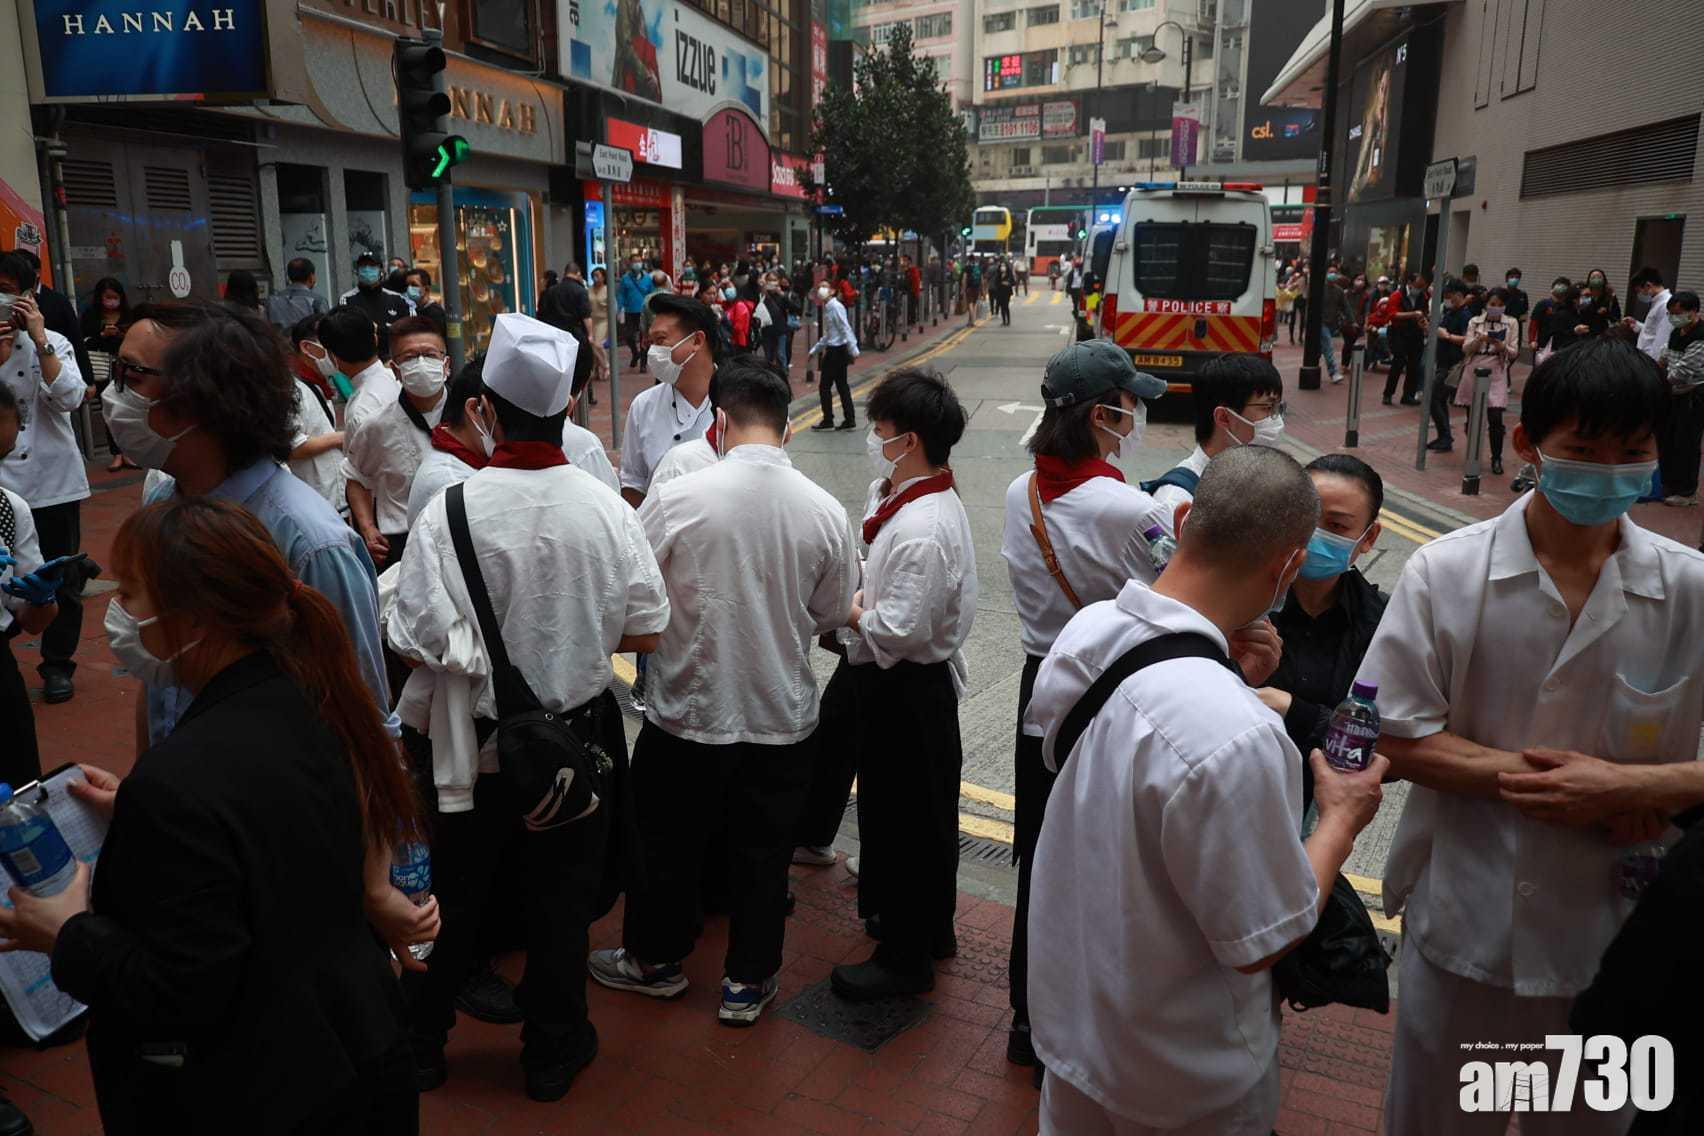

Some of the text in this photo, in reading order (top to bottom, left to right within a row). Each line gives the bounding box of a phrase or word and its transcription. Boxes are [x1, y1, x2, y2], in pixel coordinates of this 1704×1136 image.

[62, 9, 236, 35] HANNAH
[674, 8, 716, 96] izzue
[1162, 301, 1212, 313] POLICE
